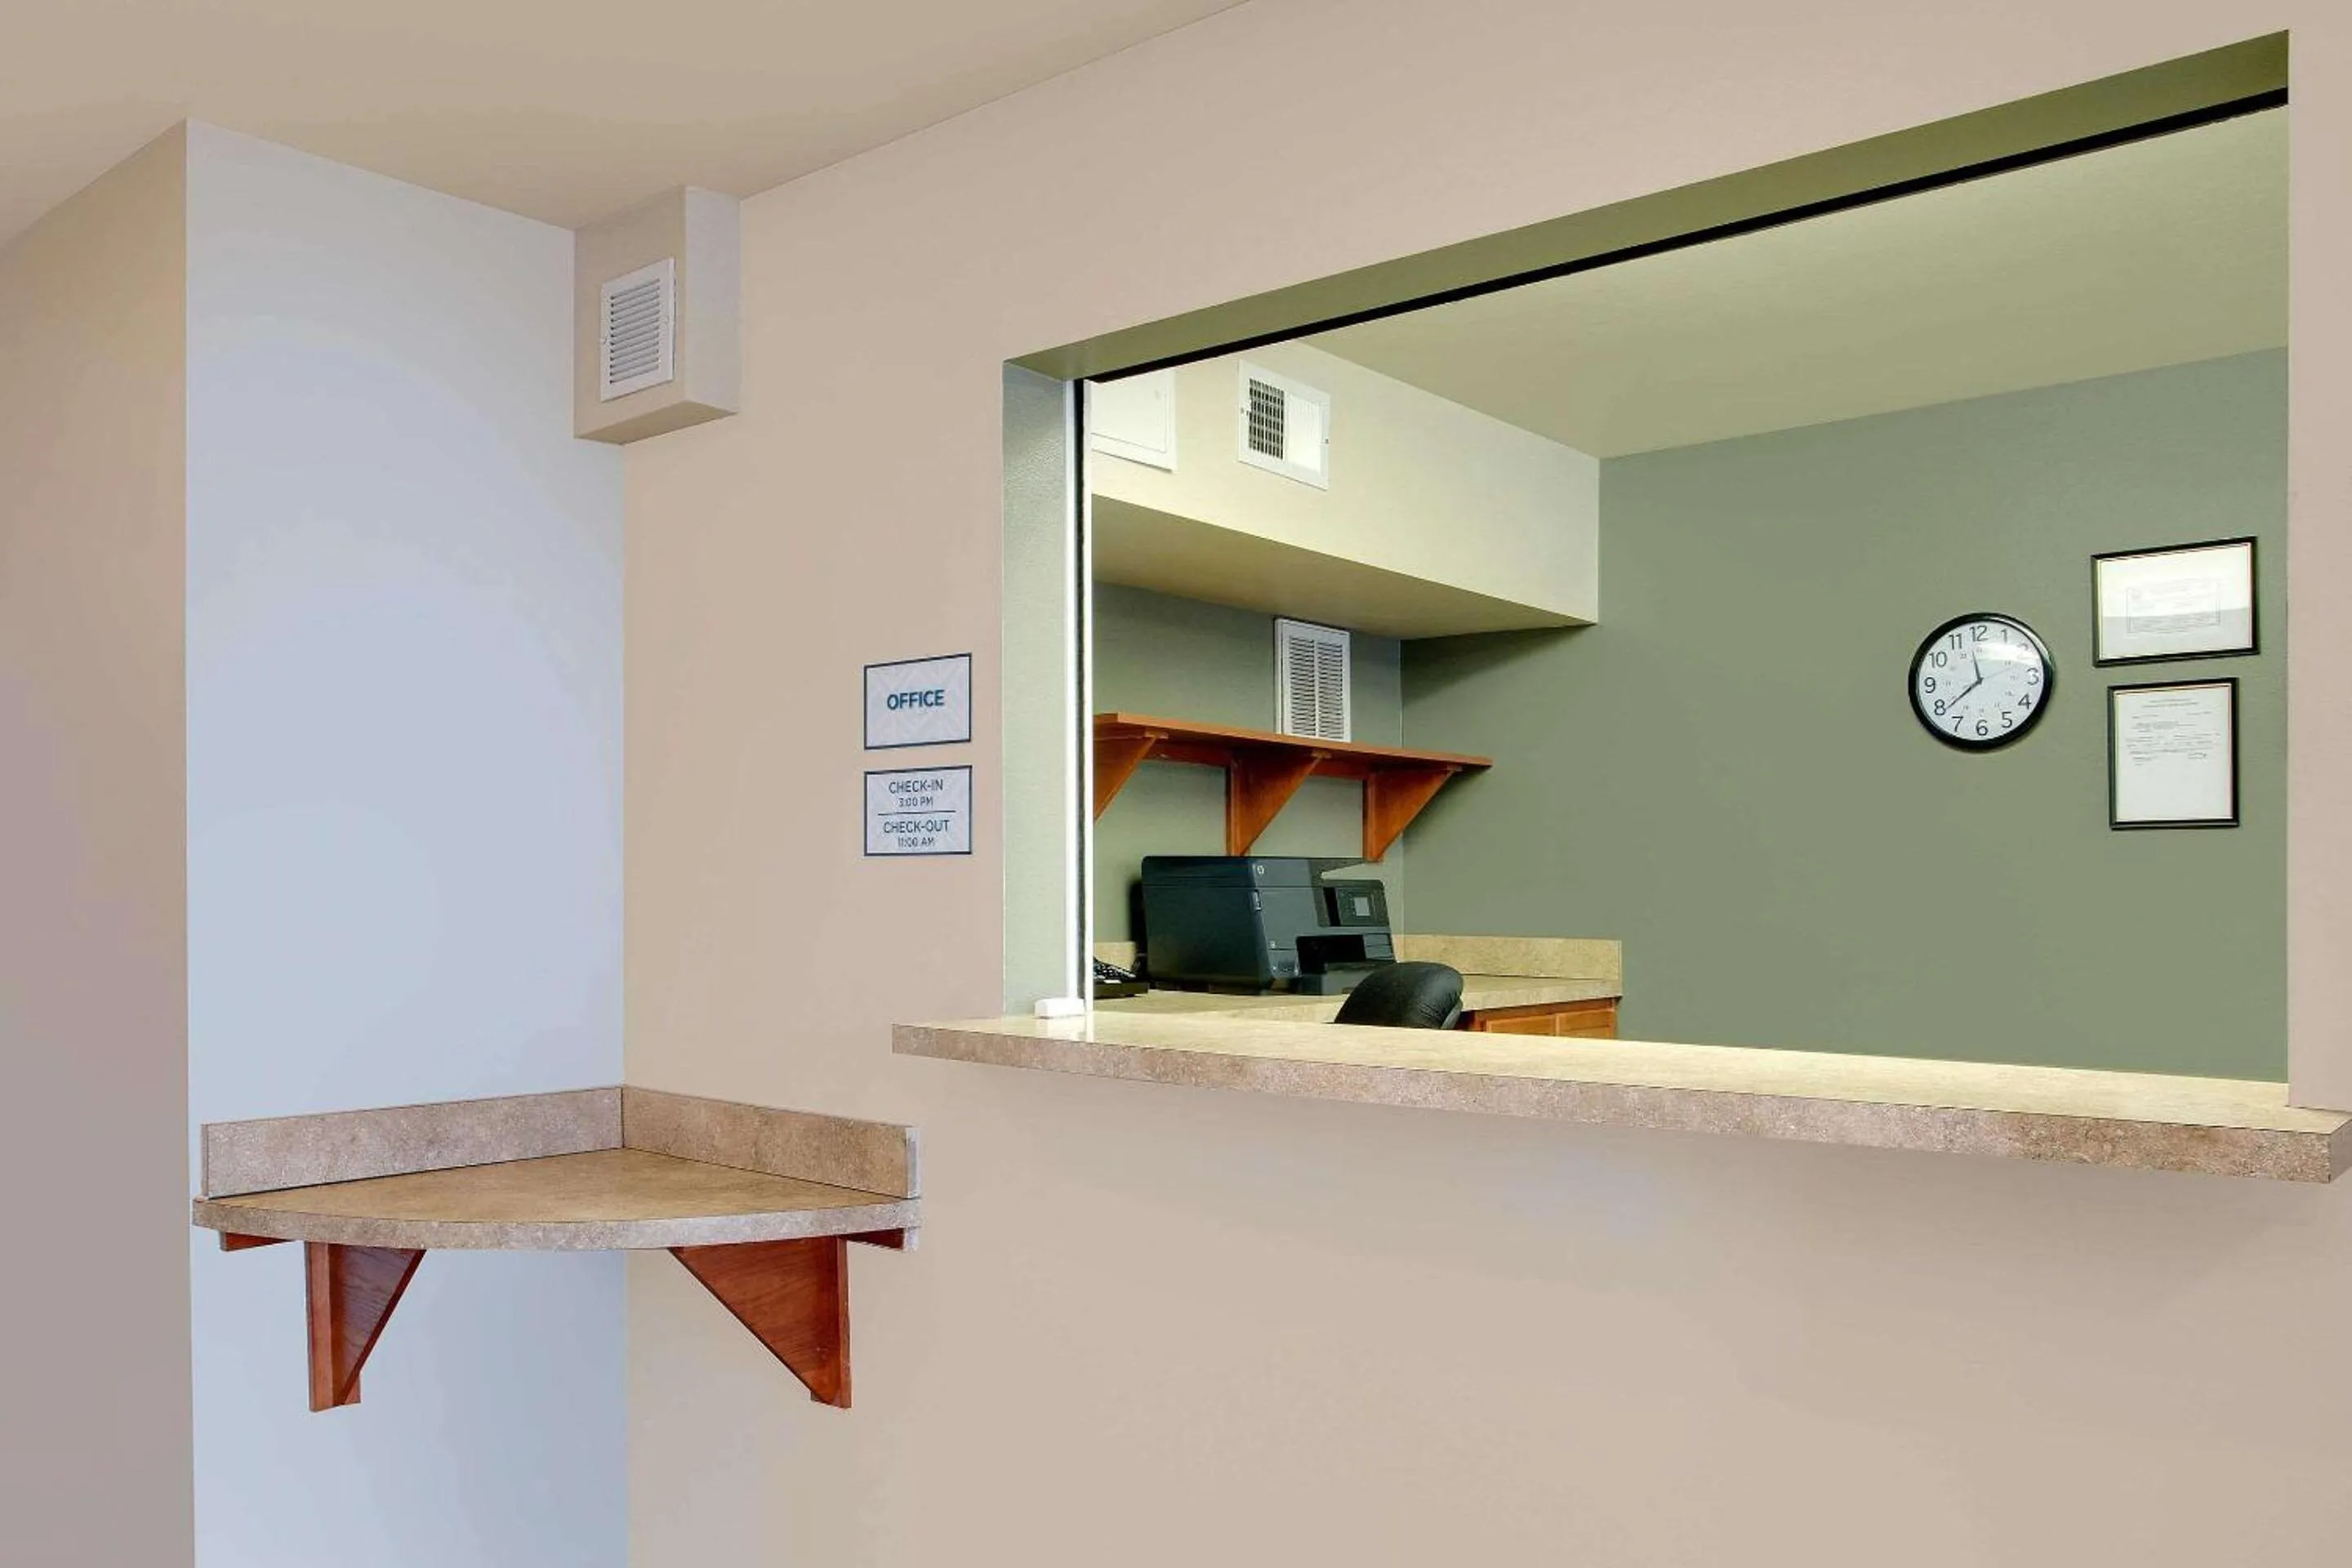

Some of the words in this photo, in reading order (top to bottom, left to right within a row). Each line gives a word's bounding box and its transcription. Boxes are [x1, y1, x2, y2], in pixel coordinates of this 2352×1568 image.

[1970, 626, 1988, 641] 12
[2001, 629, 2007, 644] 1
[1949, 634, 1962, 650] 11
[1929, 652, 1947, 668] 10
[2027, 667, 2039, 685] 3
[1924, 677, 1936, 693] 9
[887, 689, 945, 710] OFFICE
[1934, 699, 1946, 715] 8
[2018, 694, 2032, 710] 4
[1952, 716, 1963, 732] 7
[1976, 719, 1988, 736] 6
[2002, 711, 2012, 728] 5
[889, 779, 943, 794] CHECK-IN
[920, 797, 933, 806] PM
[884, 820, 949, 833] CHECK-OUT
[921, 837, 934, 847] AM
